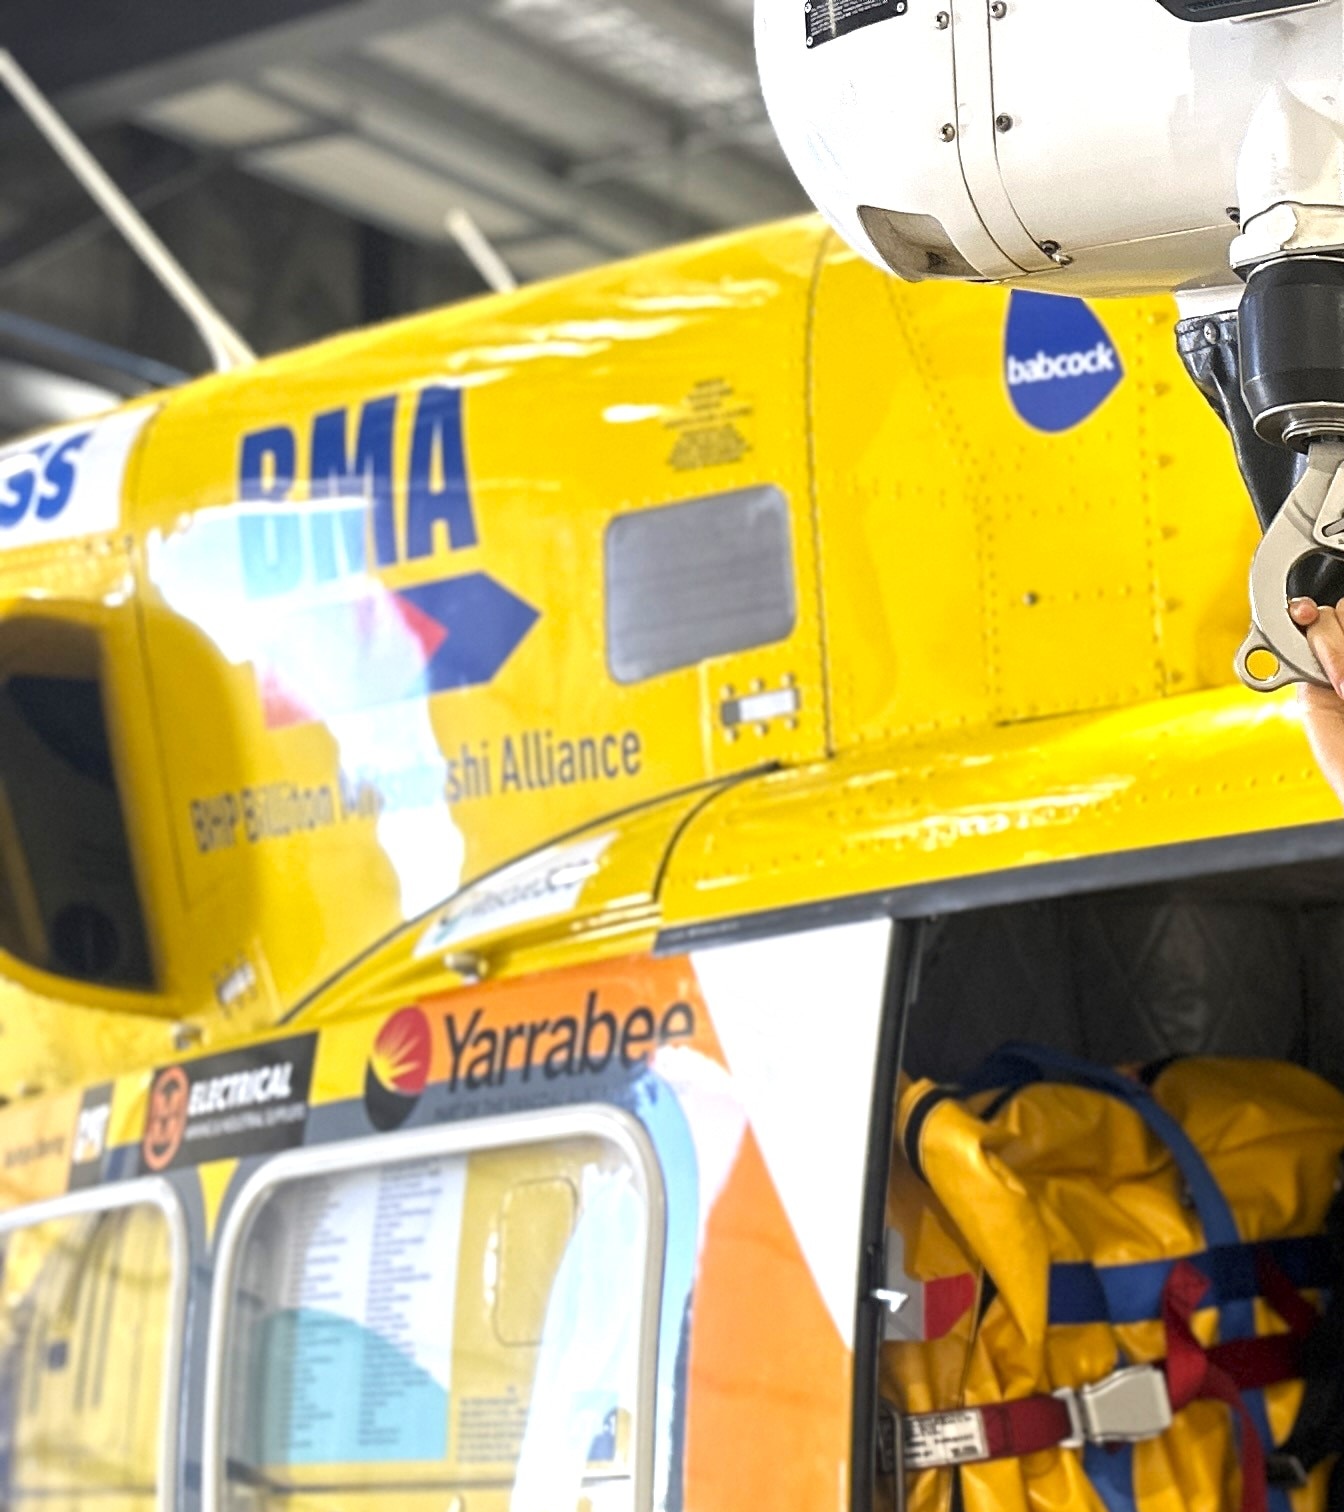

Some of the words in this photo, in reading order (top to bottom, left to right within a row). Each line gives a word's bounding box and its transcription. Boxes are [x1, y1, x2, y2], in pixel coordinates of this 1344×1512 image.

[1007, 341, 1115, 385] babcock
[238, 384, 478, 600] BMA
[190, 792, 238, 853] BHP
[501, 730, 642, 794] Alliance
[187, 1061, 294, 1117] ELECTRICAL
[444, 989, 696, 1094] Yarrabee
